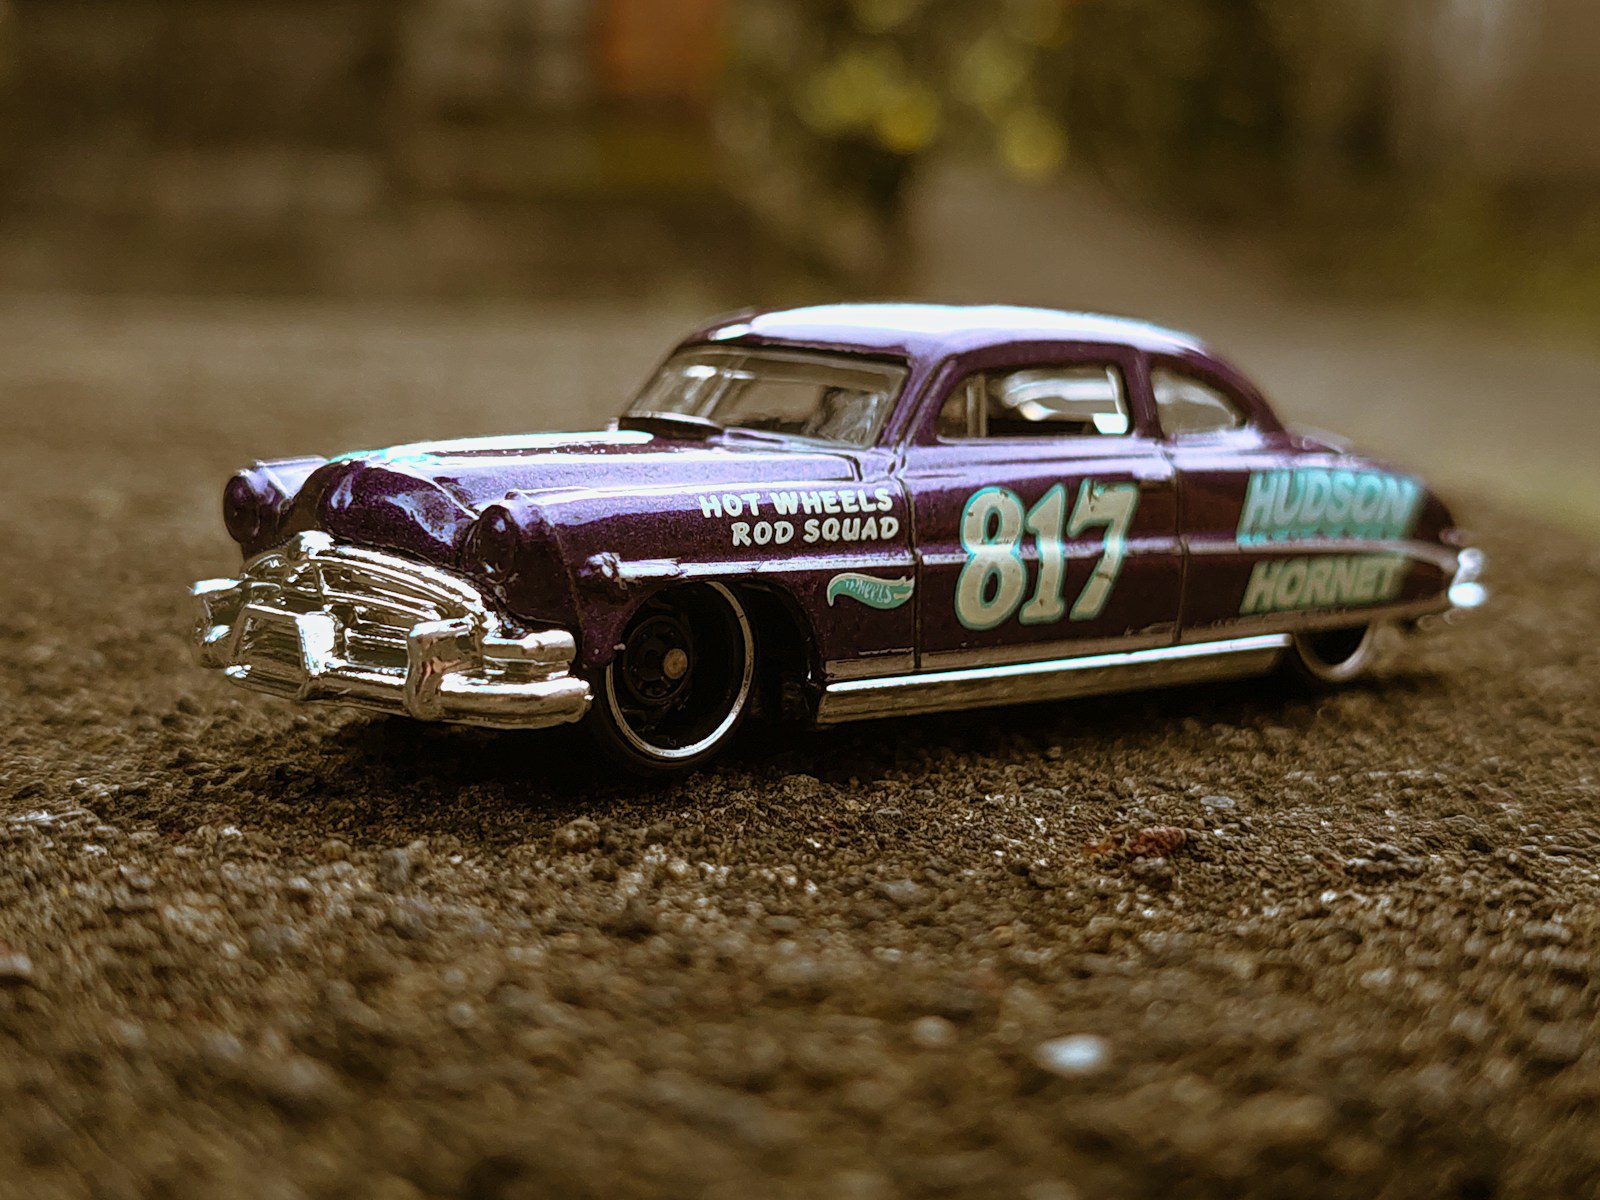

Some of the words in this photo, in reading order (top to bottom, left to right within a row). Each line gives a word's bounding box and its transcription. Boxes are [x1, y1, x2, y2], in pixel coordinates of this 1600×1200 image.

[698, 492, 762, 519] HOT
[769, 487, 894, 515] WHEELS
[730, 520, 795, 547] ROD
[802, 516, 900, 544] SQUAD
[1236, 468, 1422, 545] HUDSON
[954, 478, 1140, 631] 817
[1239, 555, 1407, 614] HORNET
